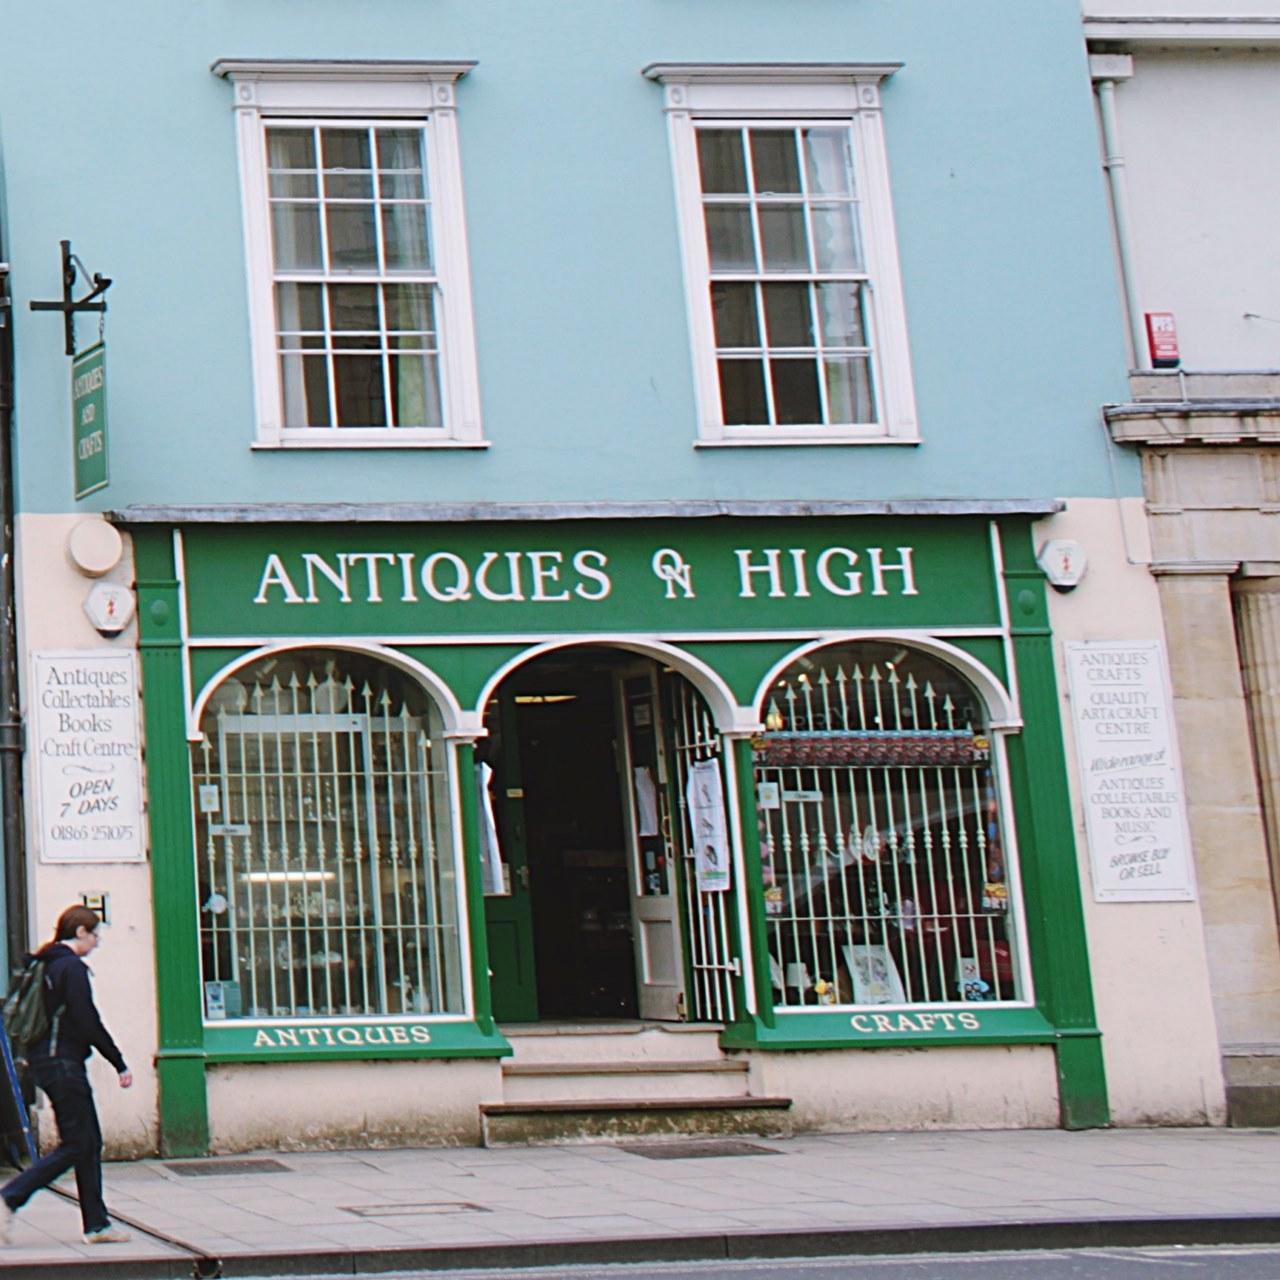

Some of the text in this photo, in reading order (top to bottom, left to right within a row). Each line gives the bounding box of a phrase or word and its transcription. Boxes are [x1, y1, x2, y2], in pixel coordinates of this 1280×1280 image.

[253, 547, 919, 603] ANTIQUES ON HIGH
[1080, 653, 1149, 666] ANTIQUES
[46, 666, 127, 688] Antiques
[1086, 667, 1142, 681] CRAFTS
[42, 689, 130, 709] Collectables
[1090, 692, 1150, 705] QUALITY
[58, 713, 112, 733] Books
[1095, 722, 1151, 734] CENTRE
[43, 738, 135, 757] Craft Centre
[69, 779, 114, 799] OPEN
[1098, 777, 1164, 790] ANTIQUES
[60, 796, 119, 818] 7 DAYS
[1091, 792, 1178, 804] COLLECTABLES
[1101, 806, 1171, 819] BOOKS AND
[51, 824, 88, 841] 01865
[1115, 822, 1156, 833] MUSIC
[1120, 862, 1162, 880] OR SELL
[850, 1012, 980, 1033] CRAFTS
[253, 1026, 432, 1048] ANTIQUES
